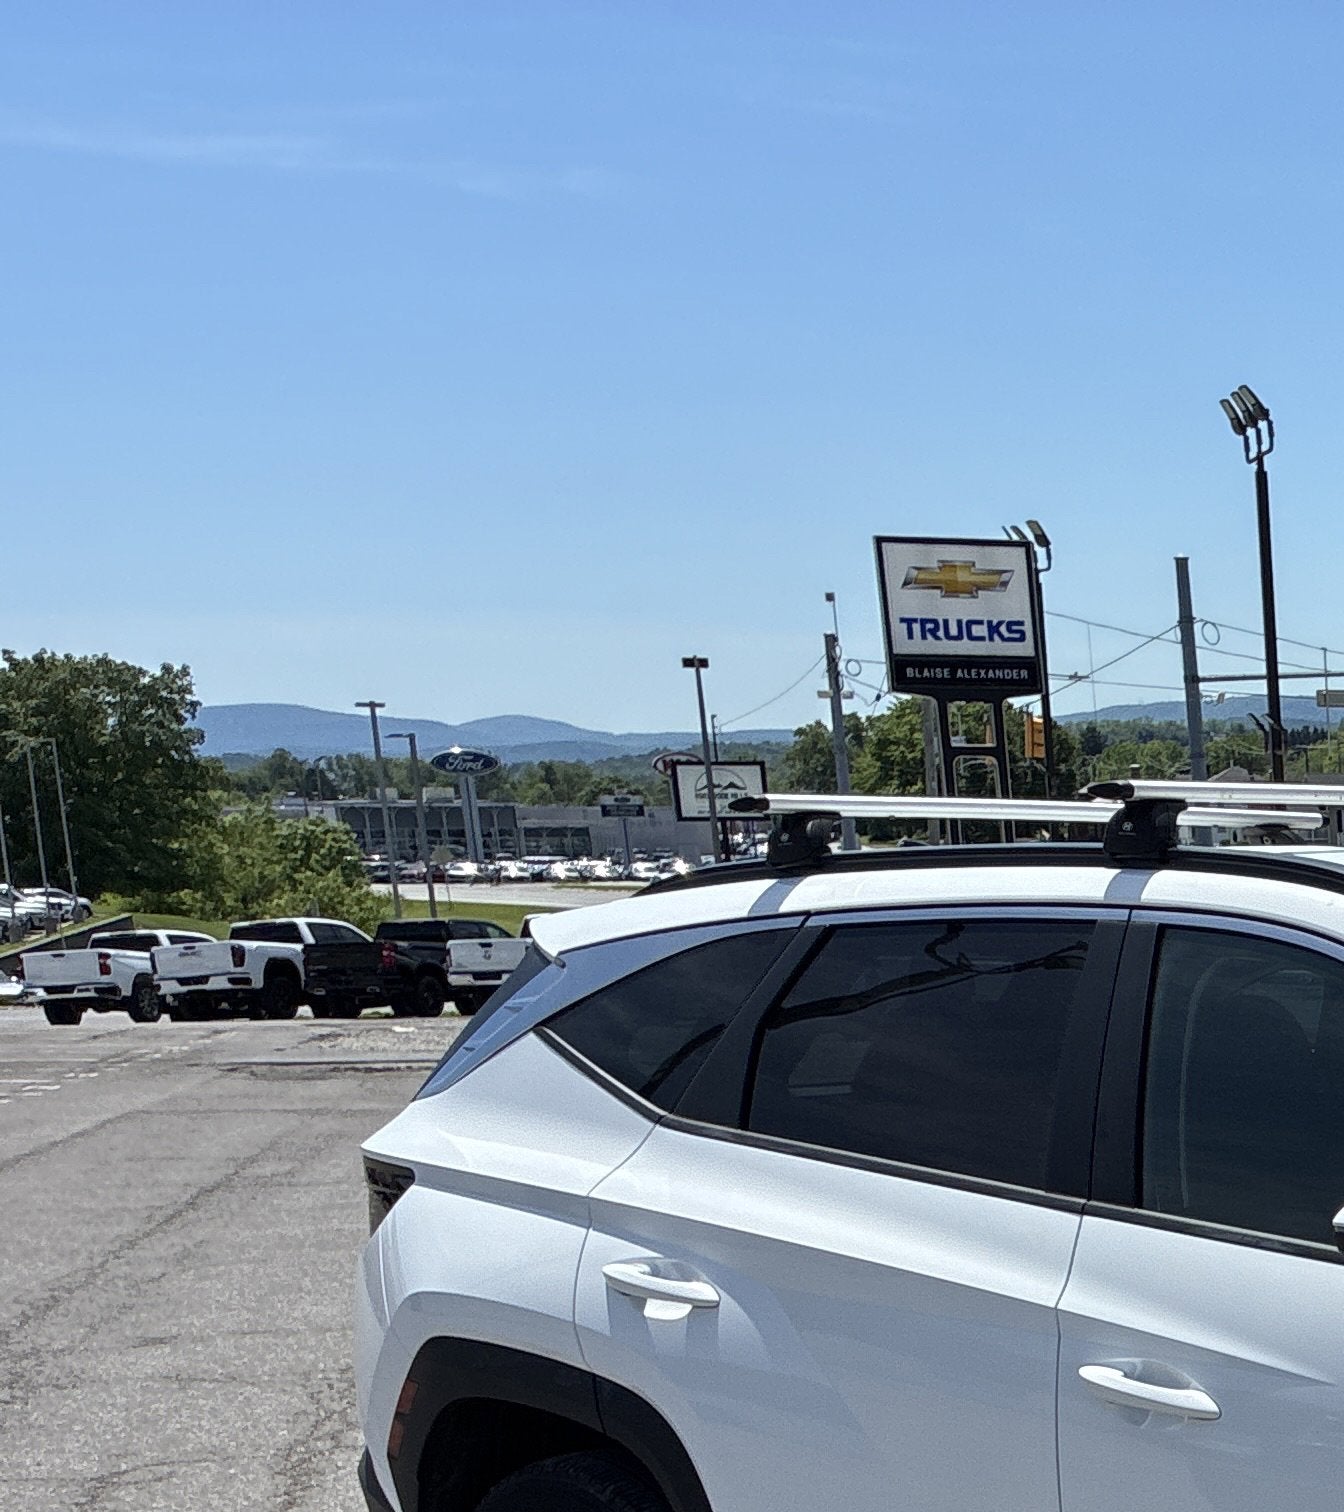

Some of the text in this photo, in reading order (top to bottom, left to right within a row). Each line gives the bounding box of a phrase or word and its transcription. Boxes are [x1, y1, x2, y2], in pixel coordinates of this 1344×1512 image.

[899, 617, 1026, 643] TRUCKS
[906, 667, 1029, 680] BLAISE ALEXANDER
[446, 755, 485, 771] Ford
